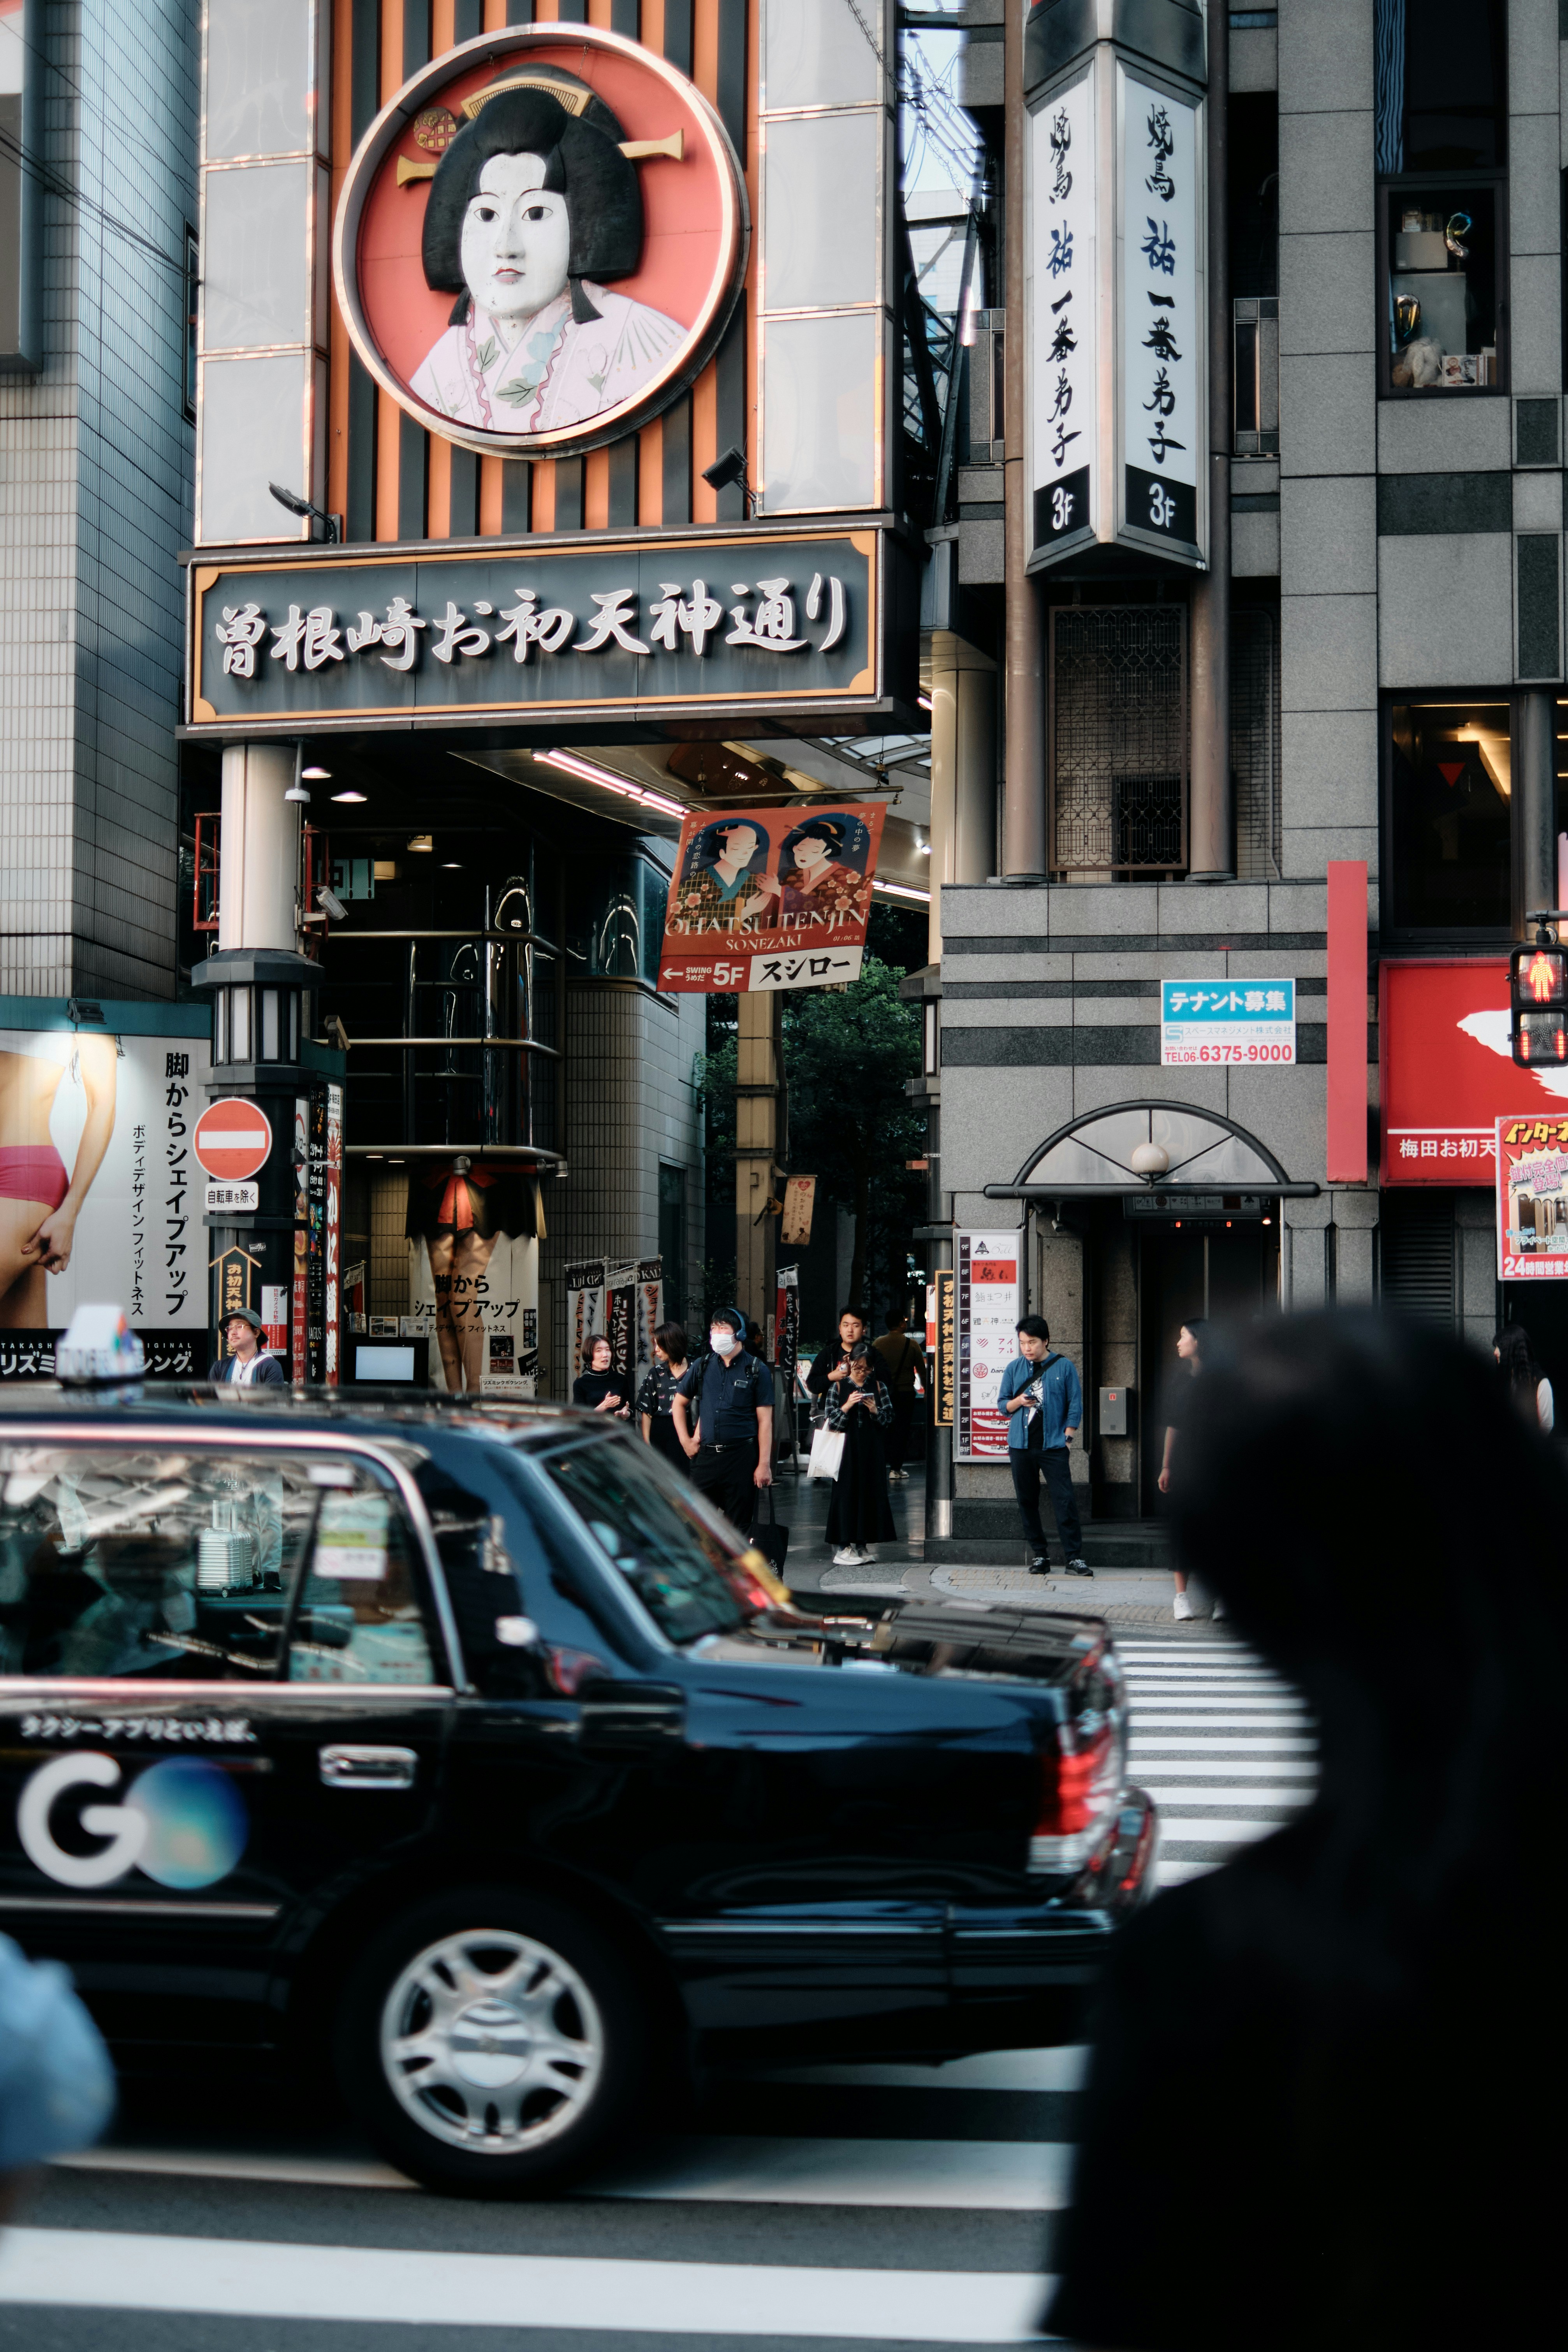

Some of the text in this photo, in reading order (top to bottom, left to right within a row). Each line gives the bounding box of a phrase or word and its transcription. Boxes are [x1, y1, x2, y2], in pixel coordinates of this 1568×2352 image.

[1052, 486, 1075, 531] 3F
[1149, 482, 1177, 528] 3F
[215, 570, 845, 678] 曽根崎お初天神通り
[686, 821, 697, 853] 幕が開く
[852, 812, 866, 852] 夢の中の夢
[866, 812, 876, 834] まるで
[690, 822, 706, 877] ふたりの恋路の
[665, 909, 868, 937] OHATSU TENJIN
[726, 935, 802, 951] SONEZAKI
[713, 962, 744, 986] 5F
[758, 956, 851, 984] スシロー
[1170, 991, 1286, 1012] テナント募集
[165, 1052, 189, 1317] 脚からシェイプアップ
[208, 1190, 255, 1205] 自転車を除く
[435, 1274, 489, 1294] 脚から
[415, 1298, 521, 1318] シェイプアップ
[468, 1324, 506, 1333] フィットネス
